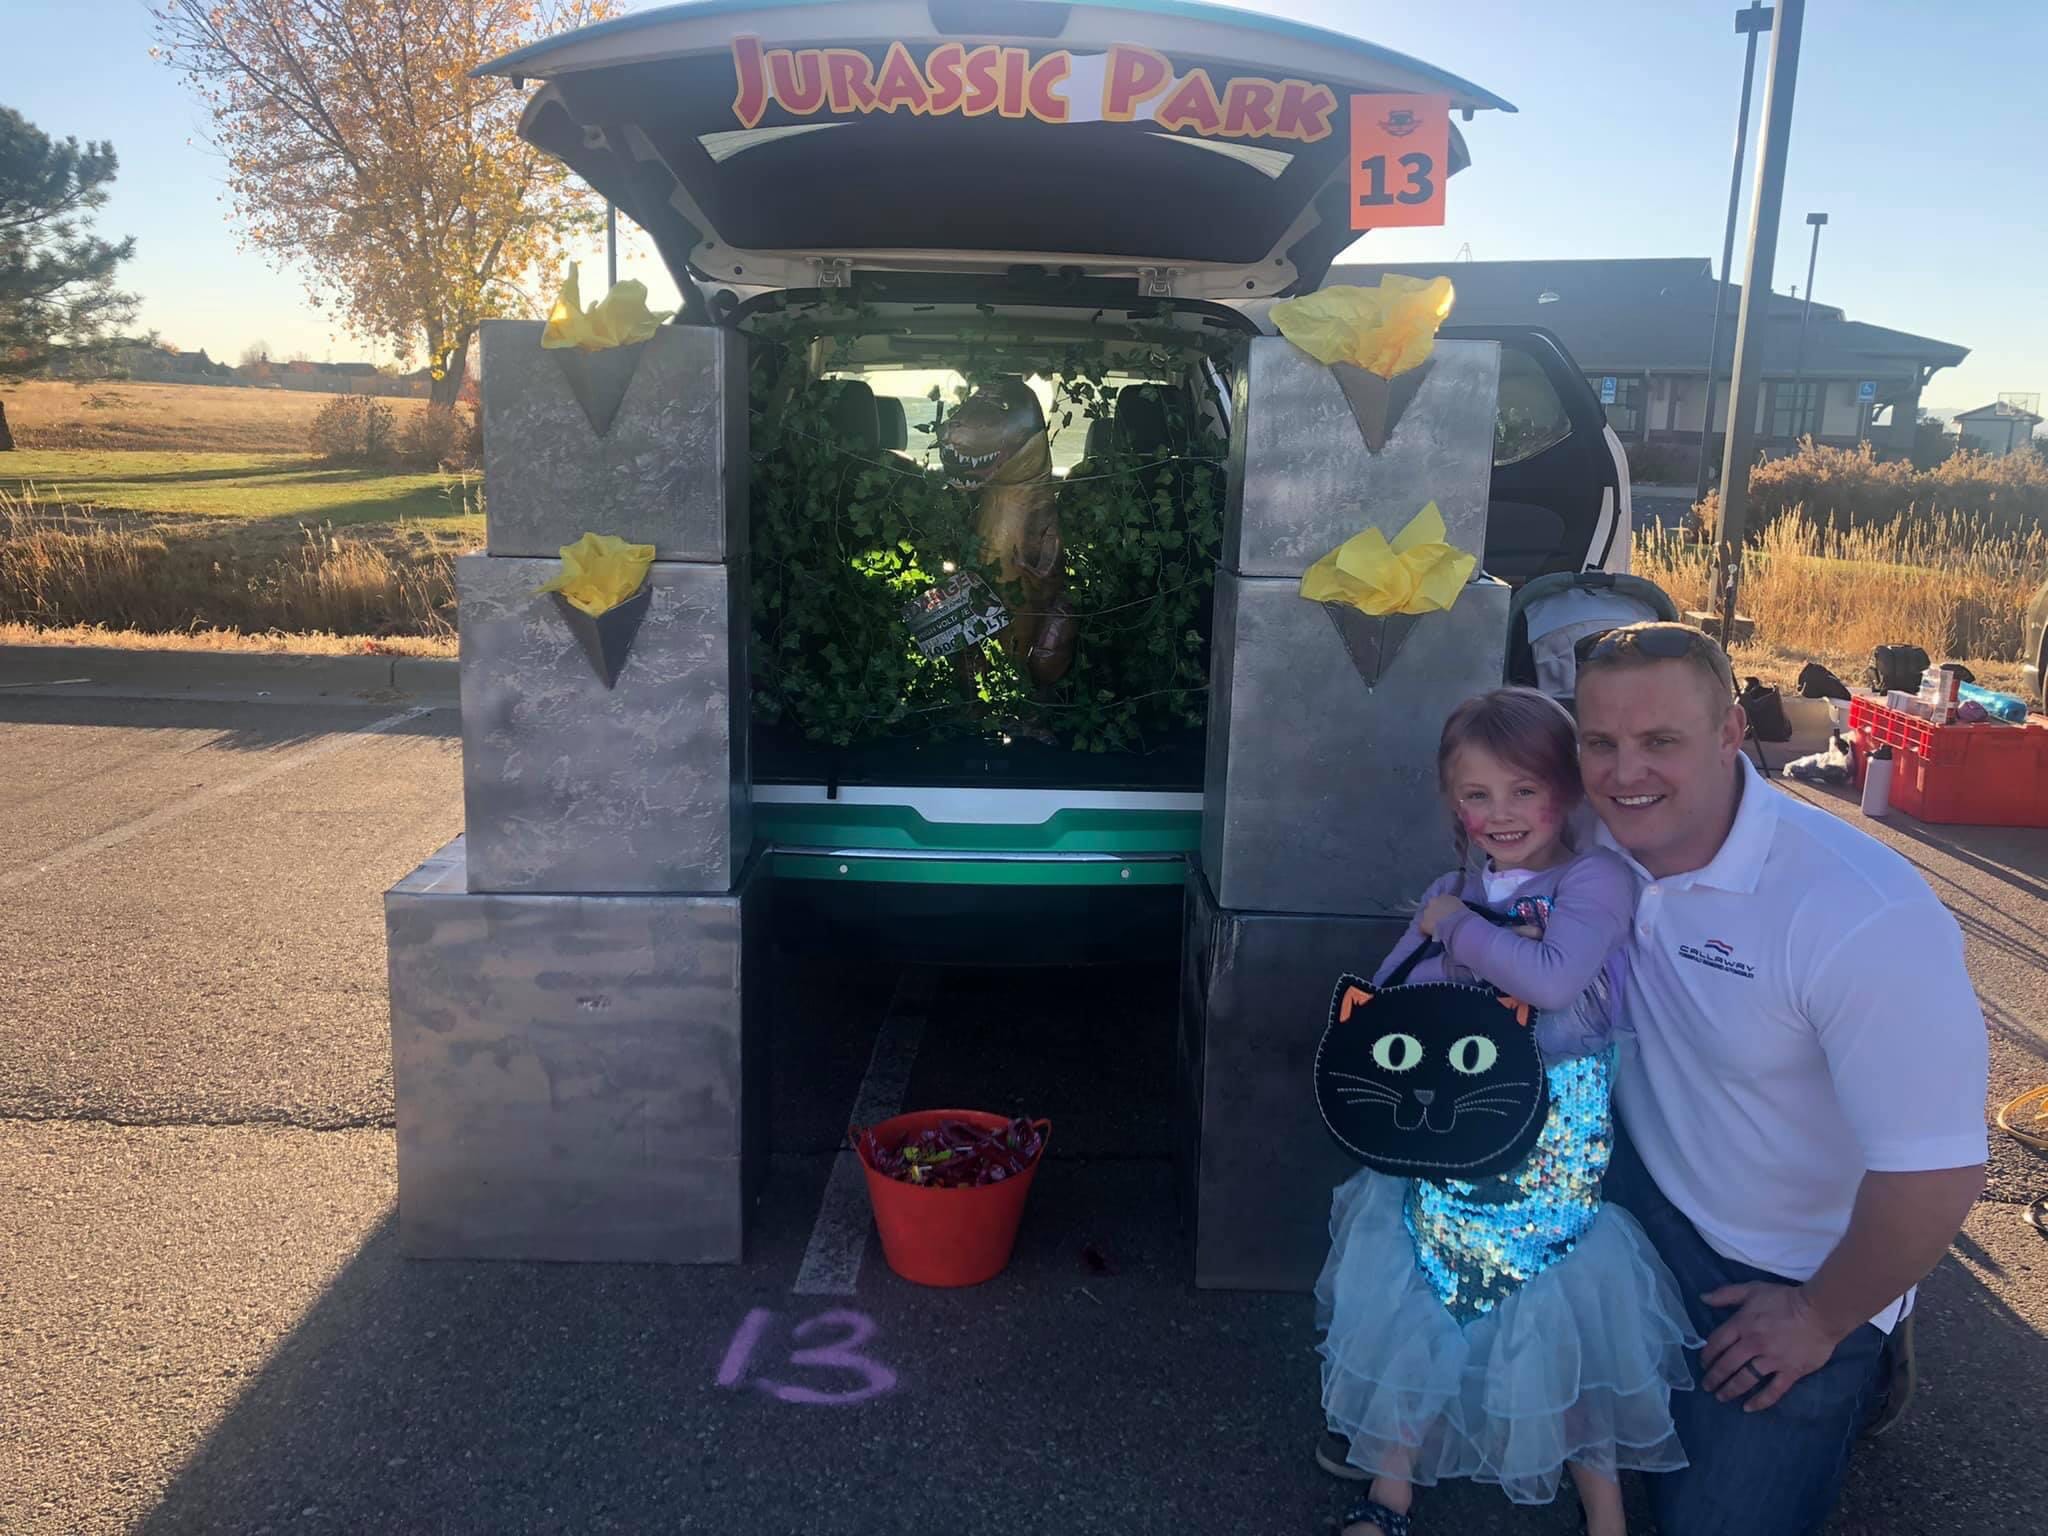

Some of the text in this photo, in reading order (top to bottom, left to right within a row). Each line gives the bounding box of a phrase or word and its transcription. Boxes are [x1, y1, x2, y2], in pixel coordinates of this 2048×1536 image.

[731, 35, 1338, 142] JURASSIC PARK
[1360, 152, 1434, 206] 13
[937, 607, 971, 629] VOLTE
[967, 610, 1008, 638] VLTS
[1680, 944, 1755, 972] CALLAWAY
[717, 1307, 897, 1403] 13
